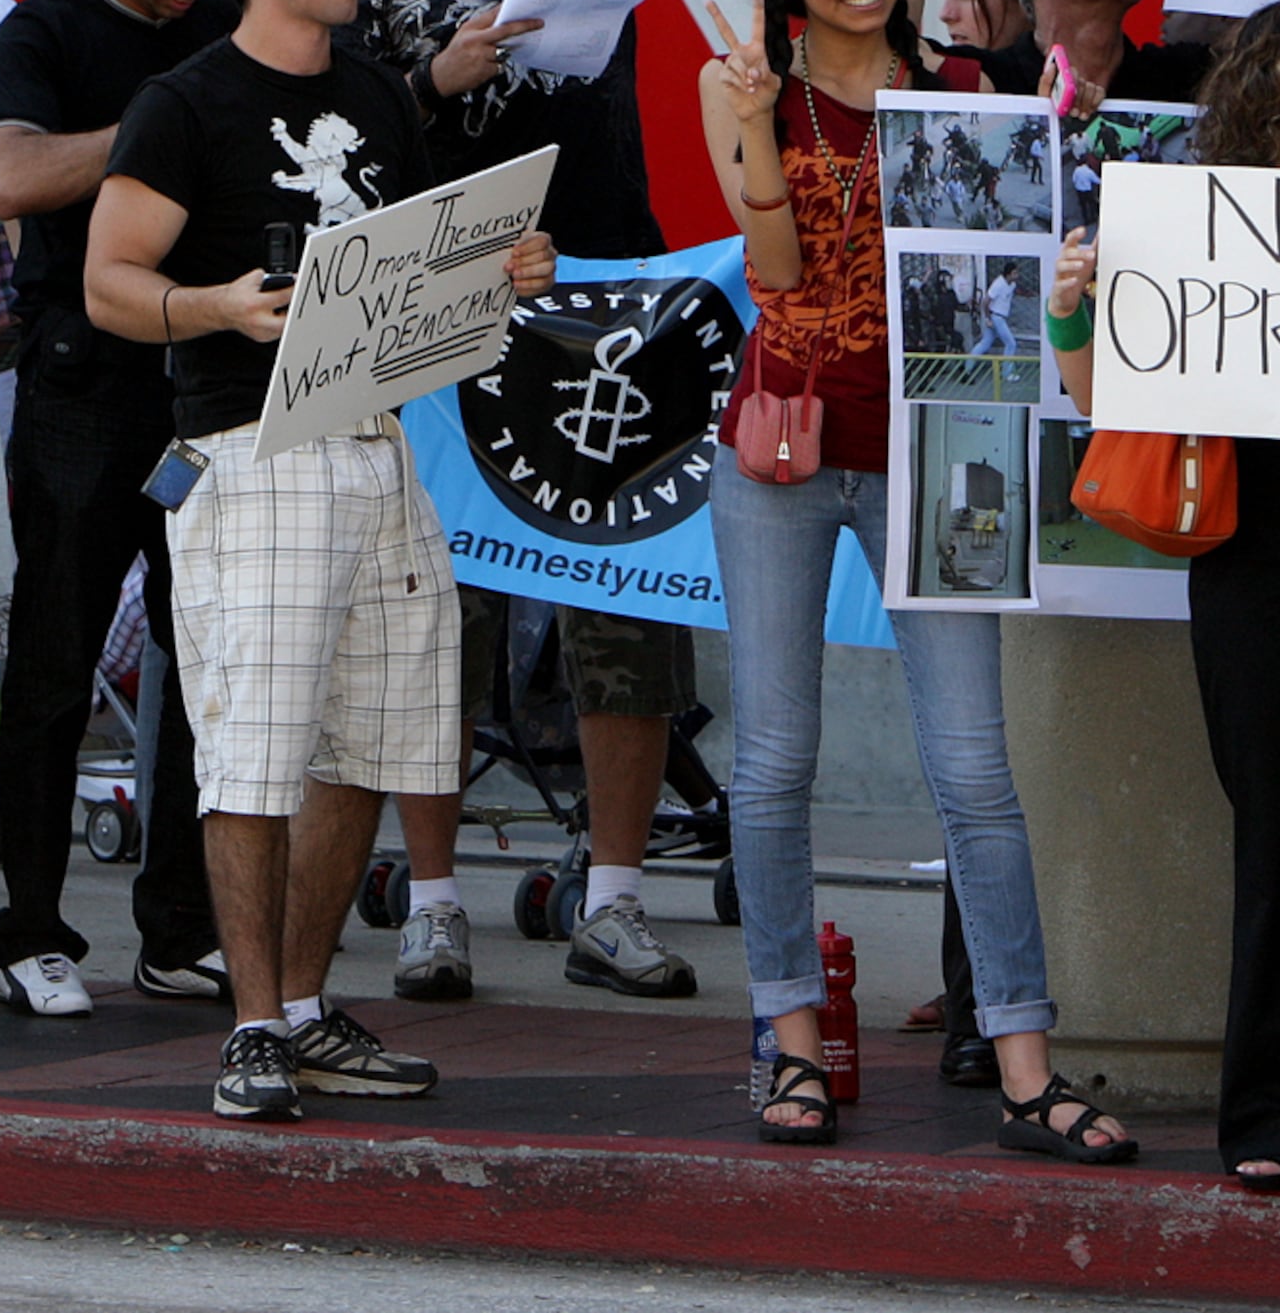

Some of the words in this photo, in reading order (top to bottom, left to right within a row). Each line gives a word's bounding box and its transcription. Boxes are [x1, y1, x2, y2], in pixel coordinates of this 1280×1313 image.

[297, 235, 368, 319] NO
[371, 249, 422, 284] more
[359, 274, 424, 330] WE
[283, 338, 367, 411] Want
